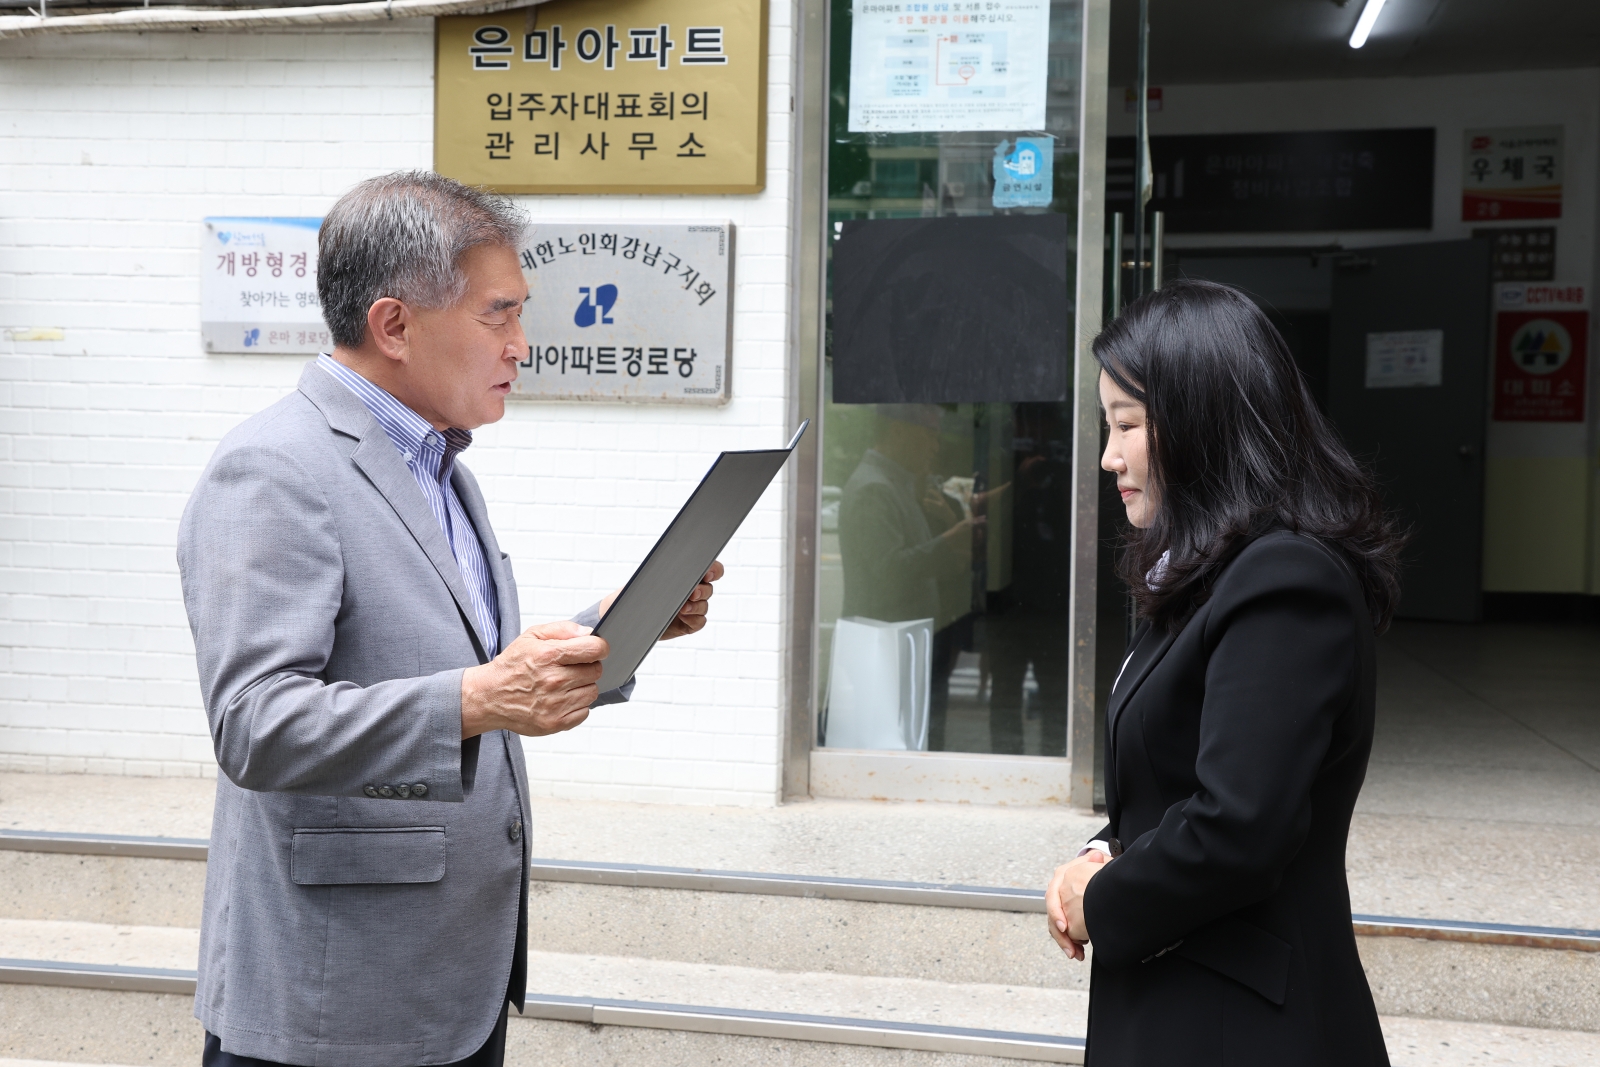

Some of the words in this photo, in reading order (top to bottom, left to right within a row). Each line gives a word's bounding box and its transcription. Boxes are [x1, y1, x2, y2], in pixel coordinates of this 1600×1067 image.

[469, 24, 728, 71] 은마아파트
[486, 91, 709, 121] 입주자대표회의
[1469, 154, 1557, 182] 우체국
[1002, 182, 1042, 193] 금연시설
[216, 250, 319, 278] 개방형경
[240, 291, 290, 308] 찾아가는
[268, 330, 290, 345] 은마
[296, 330, 330, 345] 경로당
